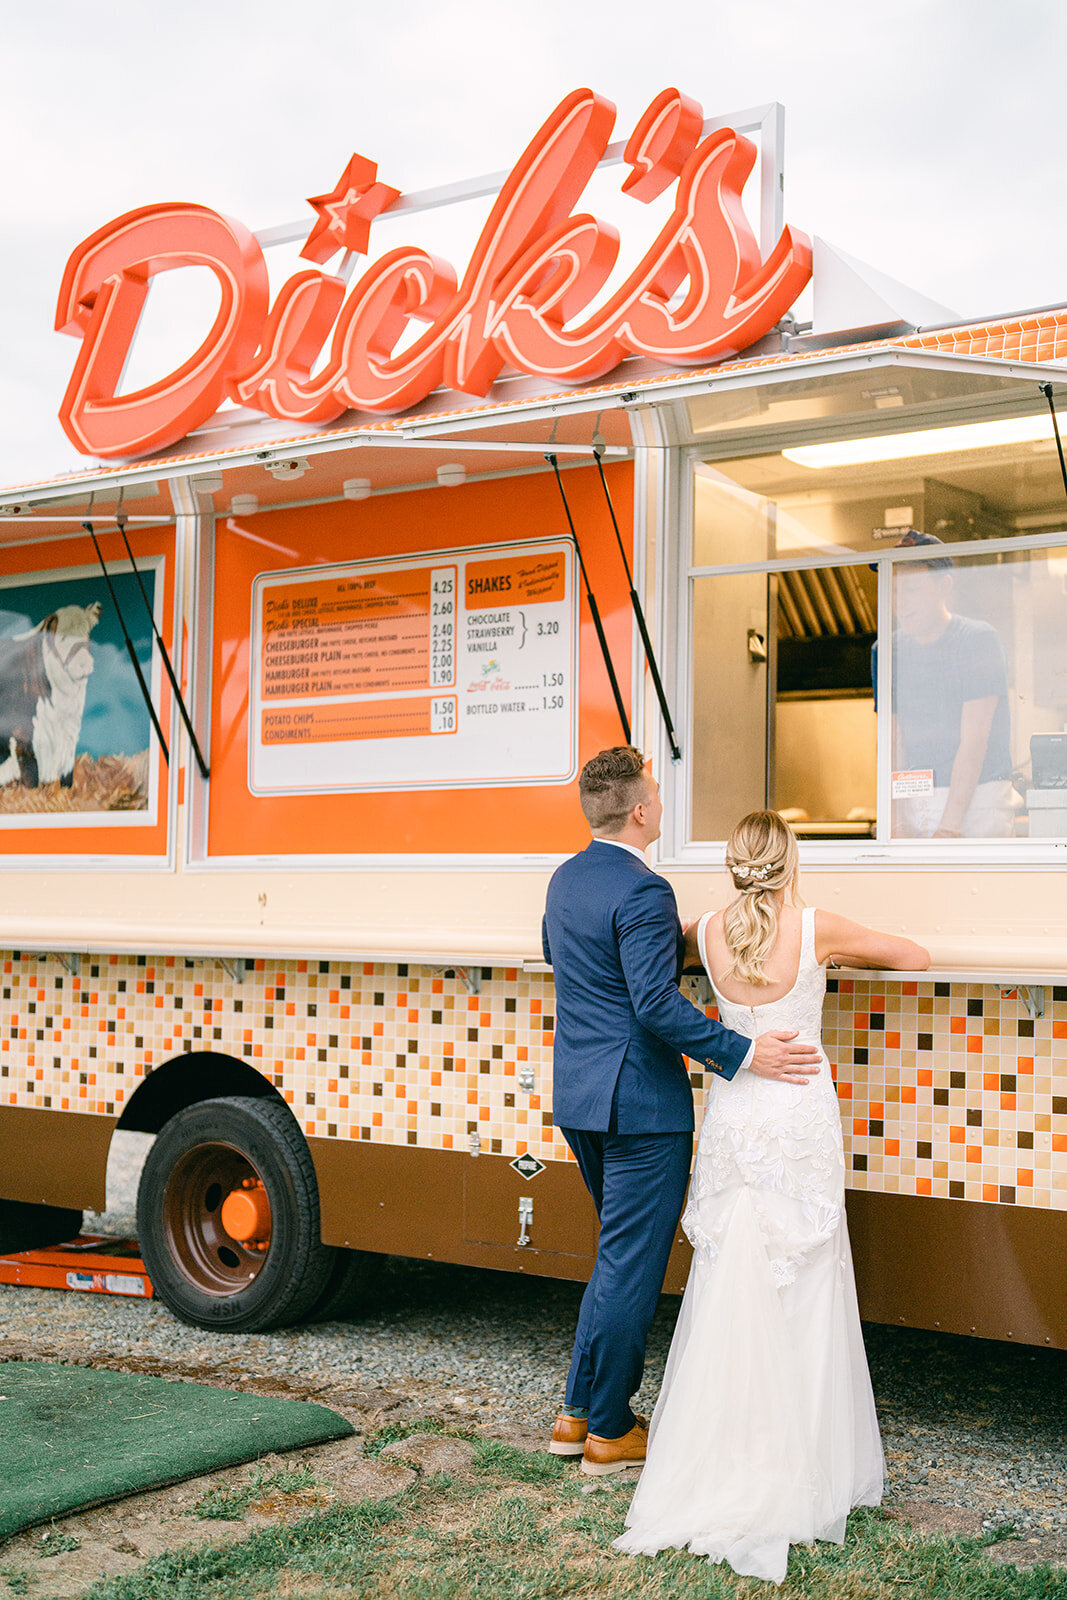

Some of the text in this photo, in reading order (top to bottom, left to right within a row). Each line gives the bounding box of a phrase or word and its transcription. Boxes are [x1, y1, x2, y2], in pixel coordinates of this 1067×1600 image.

[54, 87, 813, 460] Dick's
[292, 597, 318, 609] DELUXE
[433, 580, 453, 593] 4.25
[468, 575, 512, 594] SHAKES
[292, 617, 319, 629] SPECIAL
[432, 602, 453, 616] 2.60
[466, 612, 510, 626] CHOCOLATE
[265, 638, 319, 653] CHEESEBURGER
[432, 623, 453, 637] 2.40
[466, 621, 559, 640] STRAWBERRY 3.20
[265, 652, 319, 667] CHEESEBURGER
[320, 650, 341, 662] PLAIN
[432, 639, 453, 653] 2.25
[466, 642, 498, 653] VANILLA
[265, 668, 309, 681] HAMBURGER
[432, 655, 452, 668] 2.00
[542, 673, 564, 687] 1.50
[265, 682, 309, 696] HAMBURGER
[311, 680, 332, 692] PLAIN
[432, 670, 452, 683] 1.90
[265, 702, 454, 727] POTATO CHIPS 1.50
[466, 696, 564, 715] BOTTLED WATER 1.50
[264, 717, 453, 741] CONDIMENTS .10
